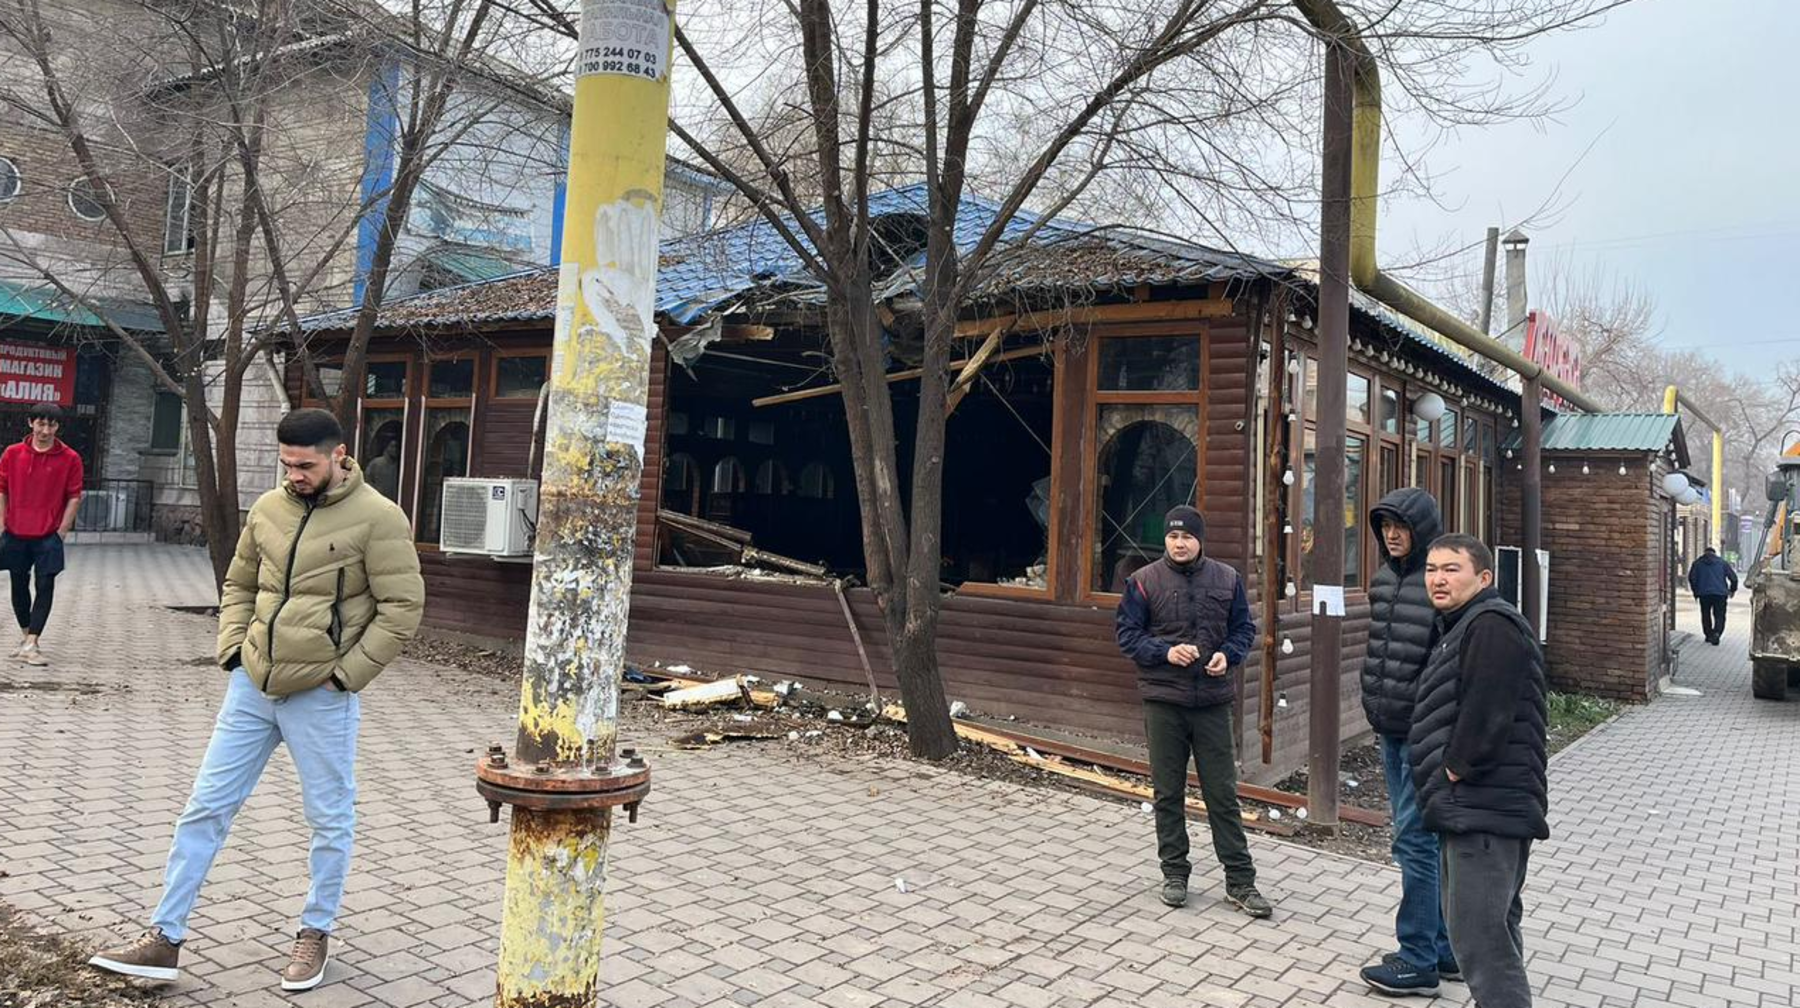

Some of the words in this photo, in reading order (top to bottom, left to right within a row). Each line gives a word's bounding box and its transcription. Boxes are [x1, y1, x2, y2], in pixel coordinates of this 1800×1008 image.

[582, 20, 659, 49] АБОТА
[603, 46, 625, 58] 244
[627, 48, 642, 60] 07
[644, 51, 657, 65] 03
[602, 60, 624, 72] 992
[626, 62, 641, 74] 68
[643, 65, 656, 79] 43
[0, 359, 63, 377] МАГАЗИН
